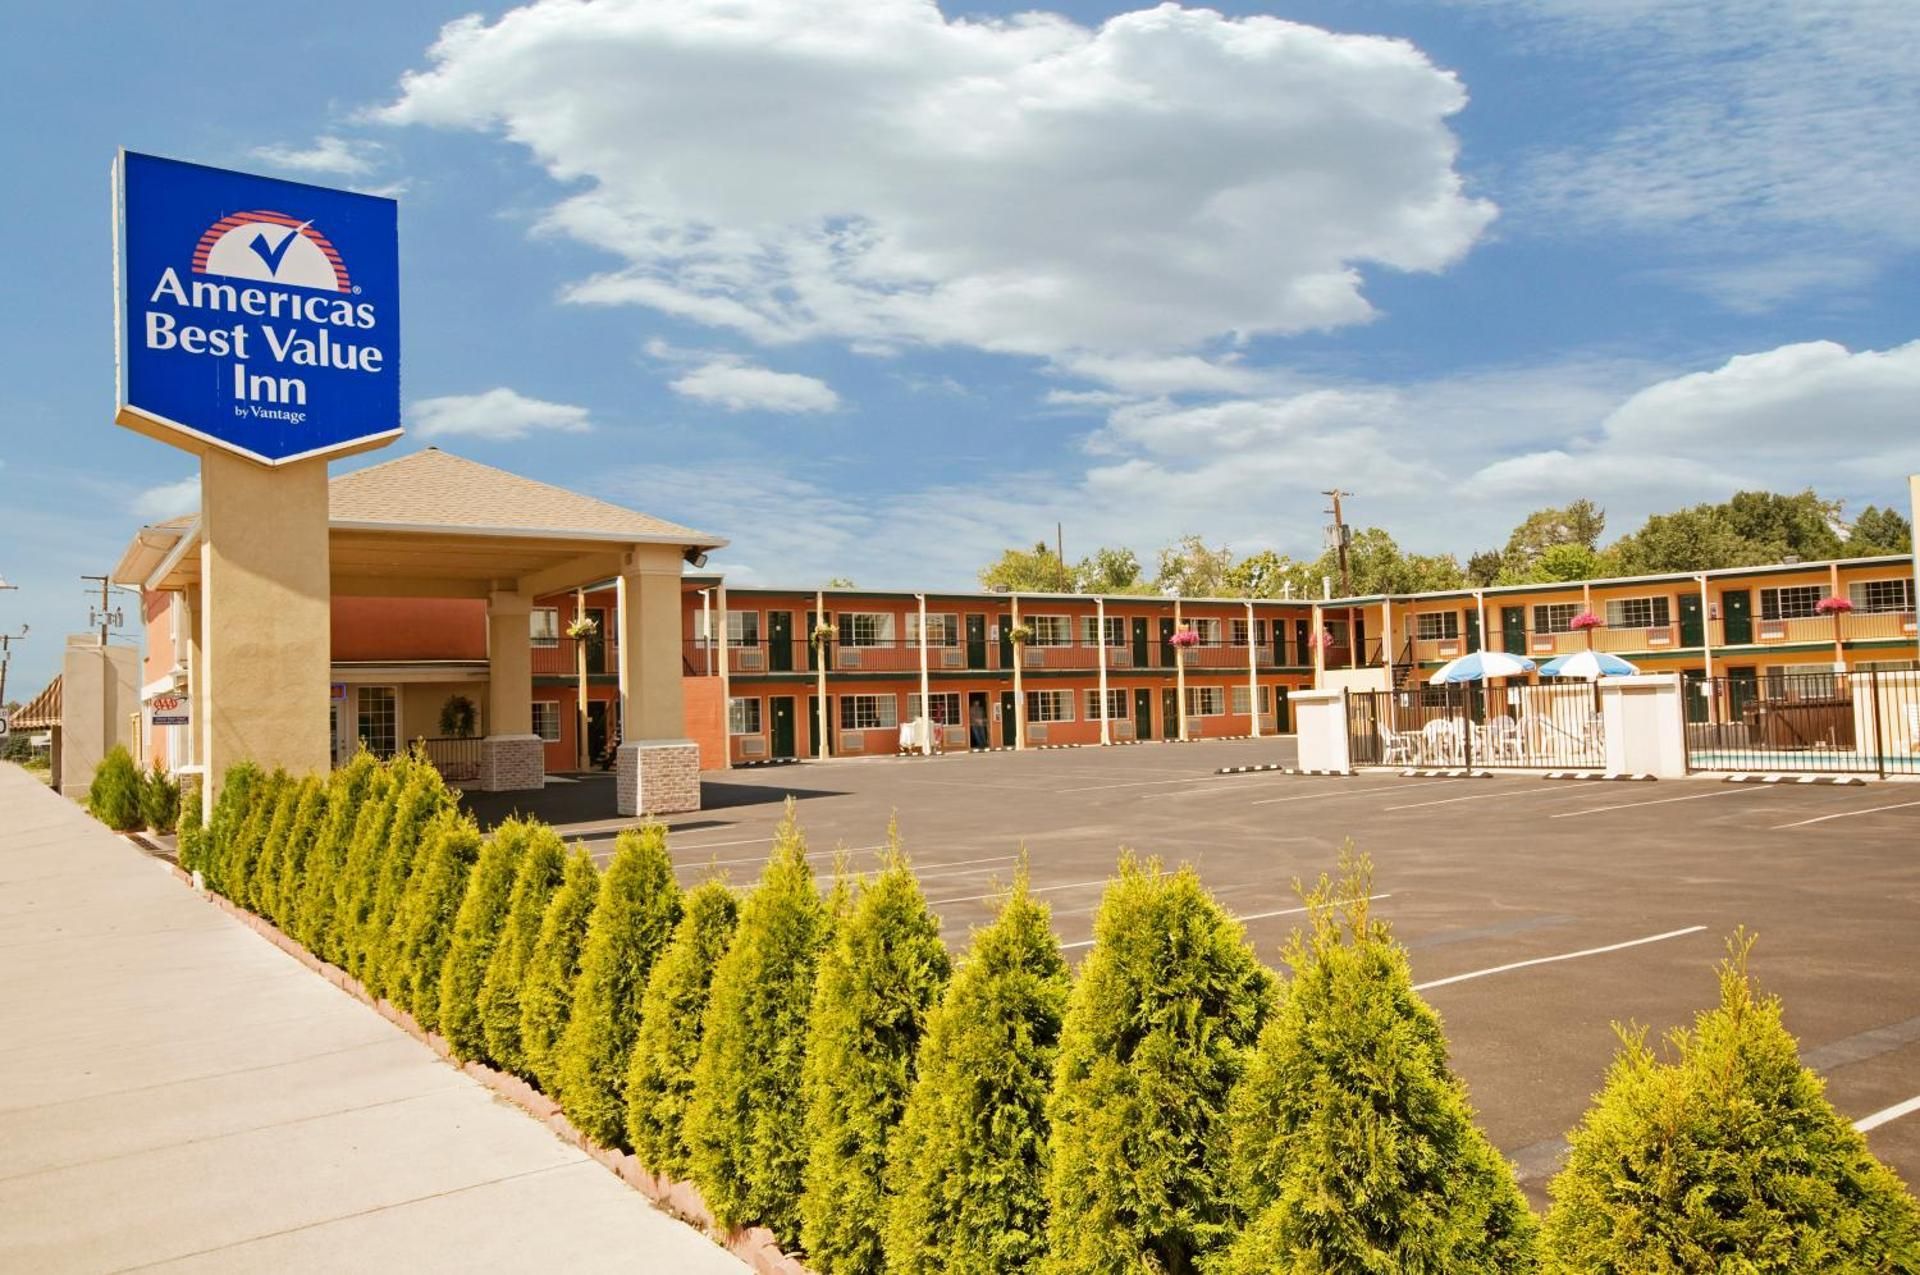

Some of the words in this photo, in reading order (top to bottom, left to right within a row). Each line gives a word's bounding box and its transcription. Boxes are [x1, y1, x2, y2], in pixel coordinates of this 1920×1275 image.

[150, 266, 376, 329] Americas
[145, 311, 249, 359] Best
[261, 325, 384, 372] Value
[234, 363, 307, 405] Inn
[234, 406, 249, 418] by
[250, 406, 307, 424] Vantage
